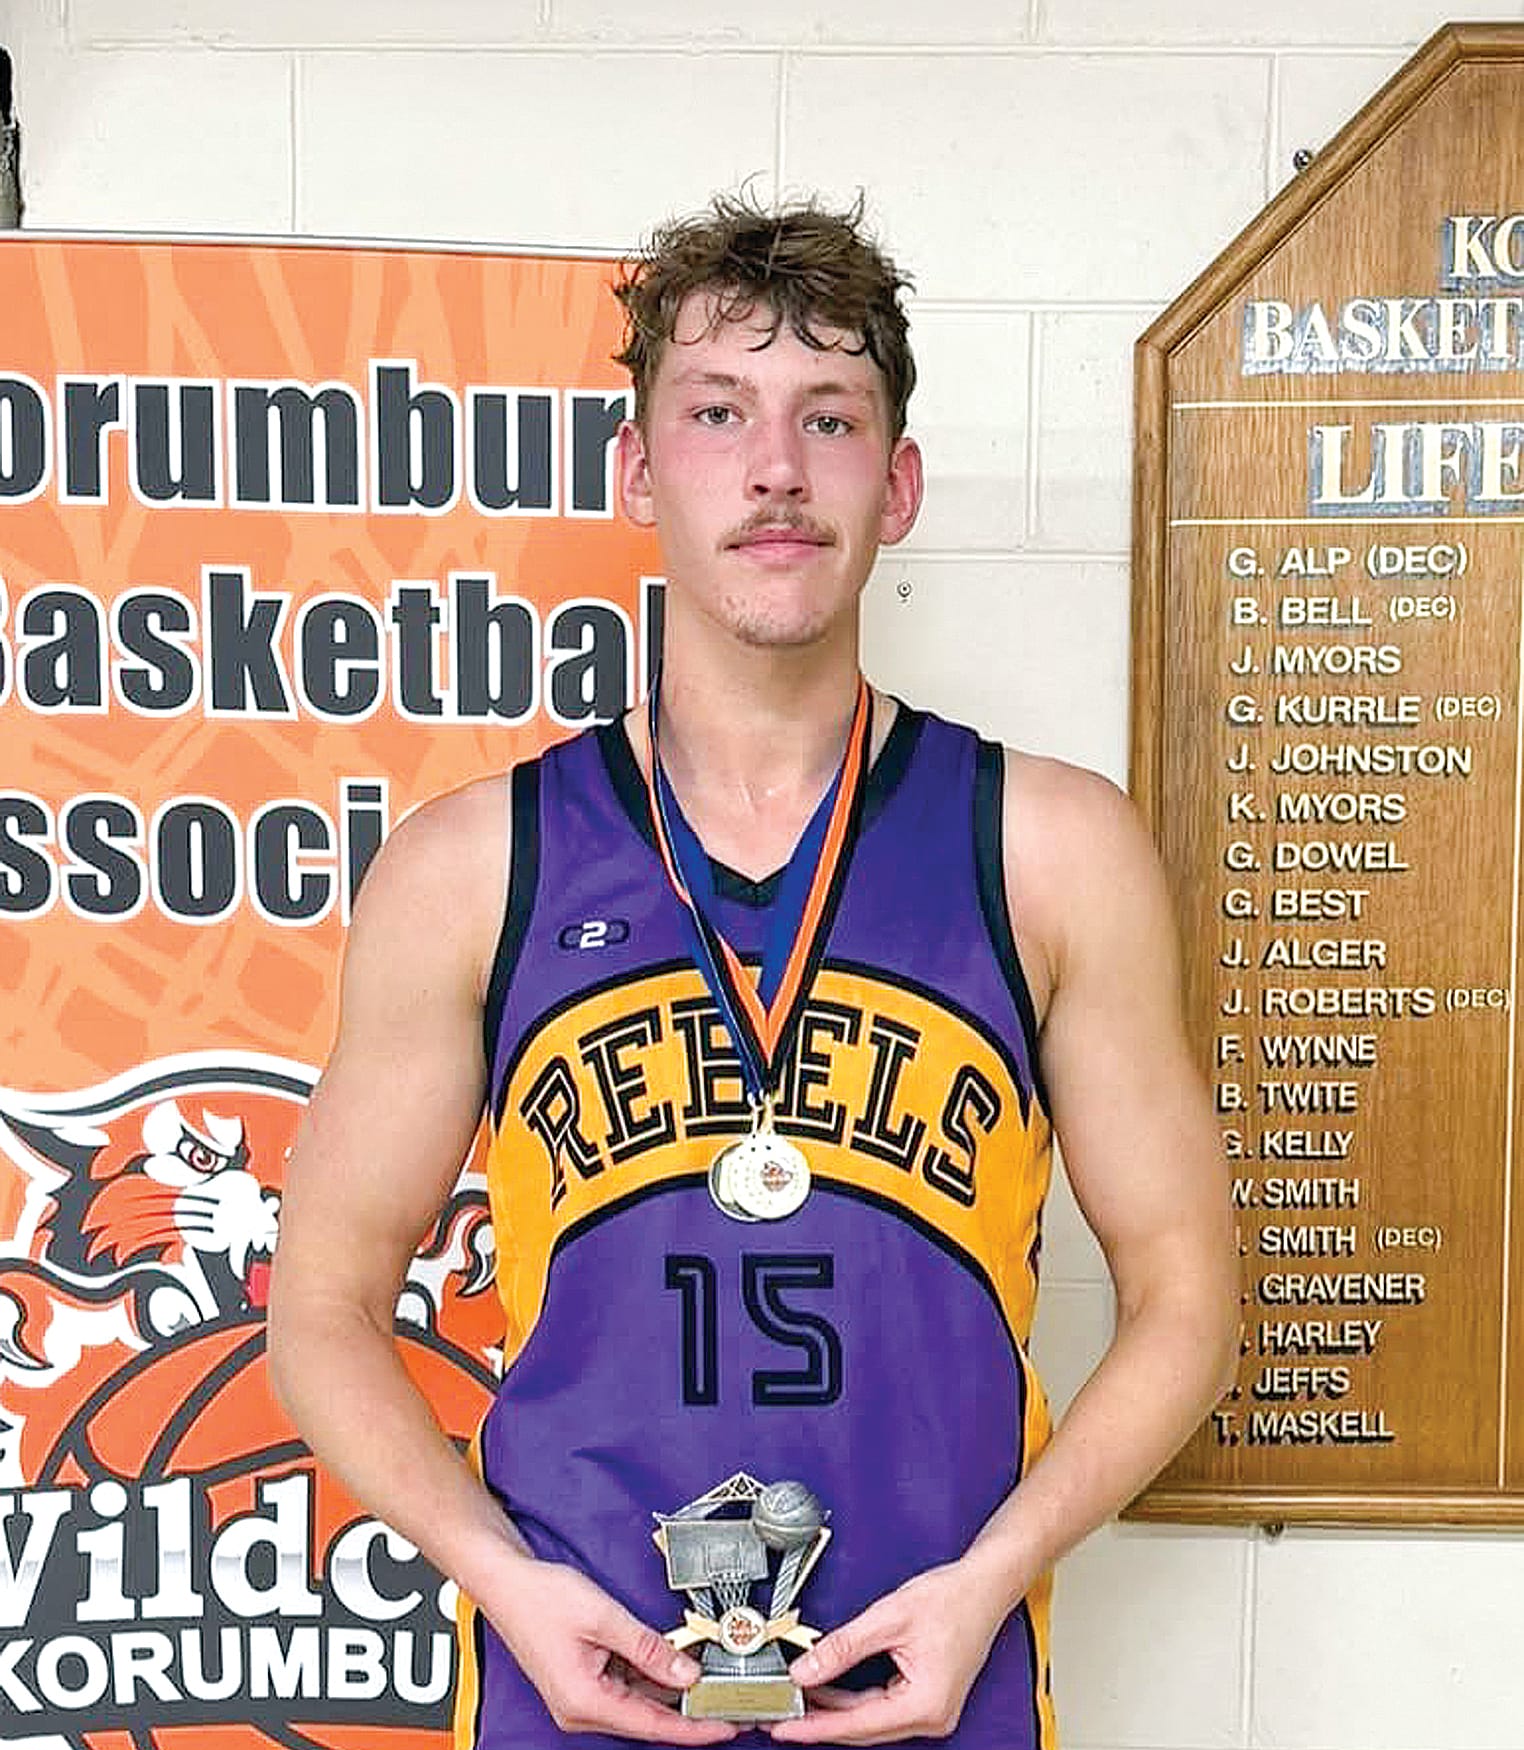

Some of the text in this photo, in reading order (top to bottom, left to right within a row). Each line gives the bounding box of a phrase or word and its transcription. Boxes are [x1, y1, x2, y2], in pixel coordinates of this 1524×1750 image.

[1253, 298, 1524, 362] BASKET
[1313, 423, 1524, 504] LIFE
[1227, 543, 1469, 579] G. ALP (DEC)
[1234, 594, 1456, 625] B. BELL (DEC)
[0, 571, 665, 721] asketba
[1231, 645, 1402, 674] J. MYORS
[1228, 695, 1502, 724] G. KURRLE (DEC)
[1228, 744, 1472, 773] J. JOHNSTON
[1230, 793, 1406, 821] K. MYORS
[1227, 841, 1409, 870] G. DOWEL
[1226, 889, 1370, 917] G. BEST
[1222, 939, 1387, 967] J. ALGER
[1223, 988, 1510, 1015] J. ROBERTS (DEC)
[1220, 1035, 1377, 1062] F. WYNNE
[520, 993, 1000, 1216] REBELS
[1220, 1082, 1358, 1110] B. TWITE
[1263, 1130, 1354, 1157] KELLY
[1265, 1178, 1359, 1204] SMITH
[1262, 1226, 1356, 1252] SMITH
[1376, 1227, 1443, 1252] (DEC)
[1263, 1273, 1425, 1301] GRAVENER
[664, 1253, 843, 1406] 15
[1262, 1320, 1381, 1348] HARLEY
[1256, 1367, 1350, 1395] JEFFS
[1213, 1411, 1394, 1439] T. MASKELL
[0, 1474, 458, 1629] ildc
